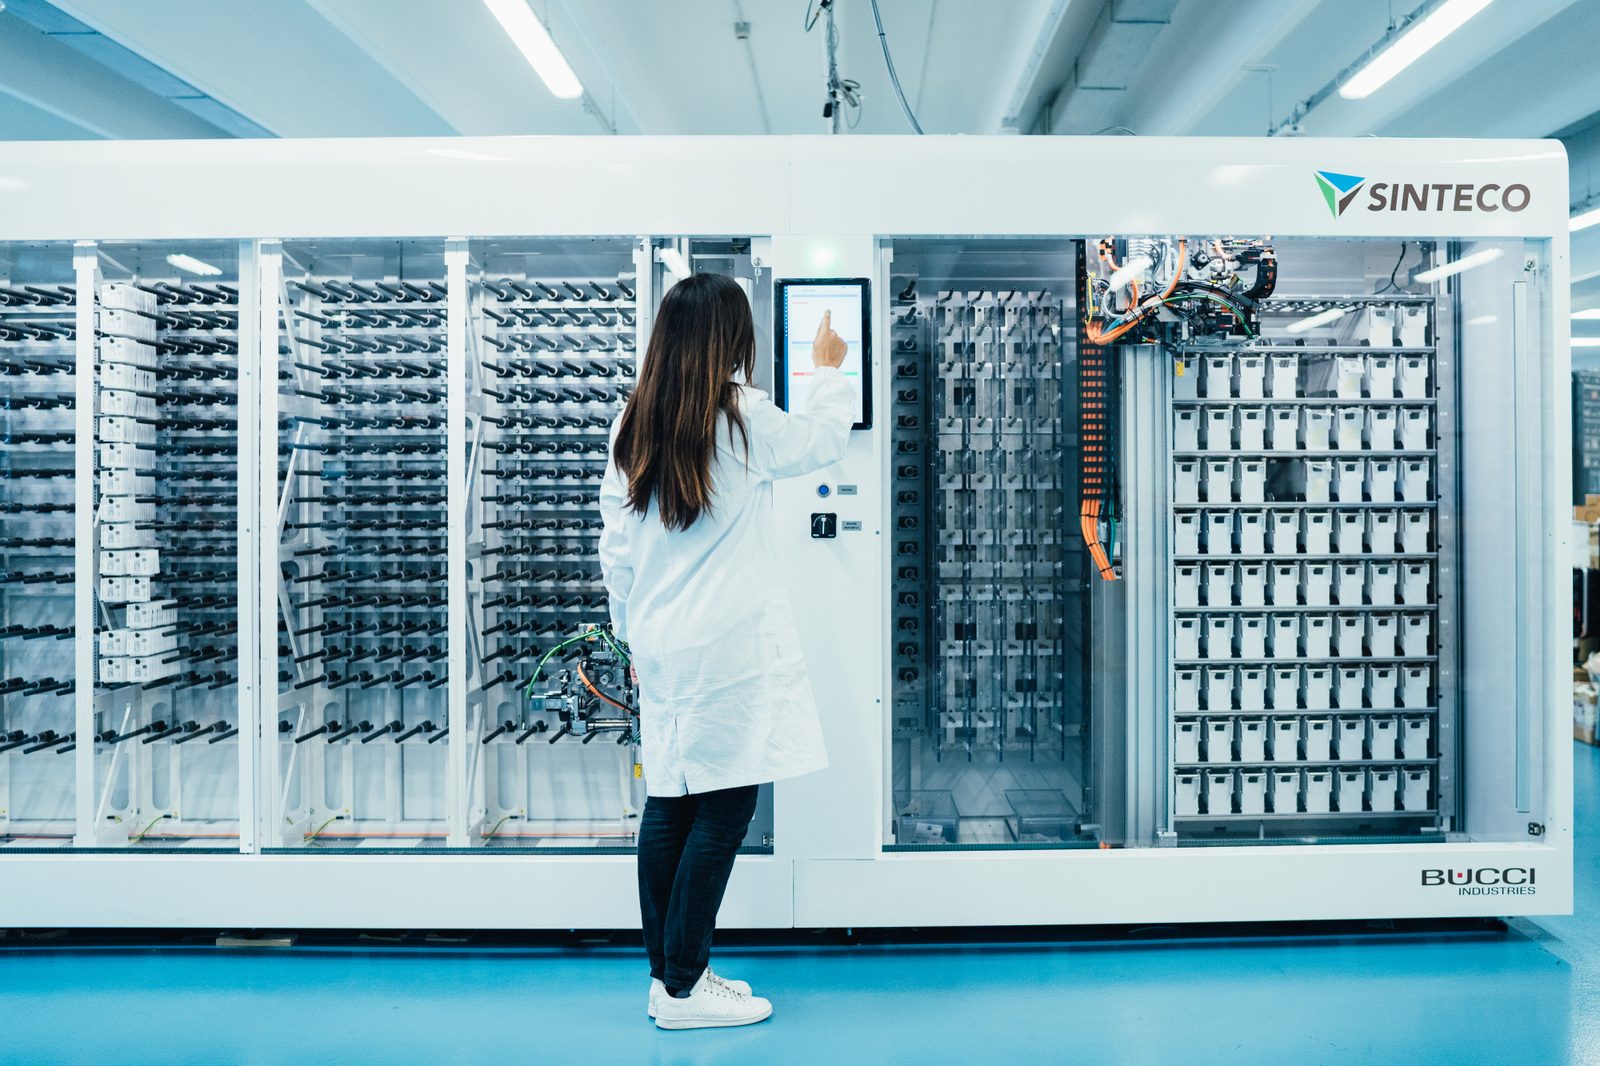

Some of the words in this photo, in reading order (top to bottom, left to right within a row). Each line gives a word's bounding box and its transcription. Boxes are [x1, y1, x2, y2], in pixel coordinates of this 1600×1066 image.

[1367, 183, 1531, 212] SINTECO
[1421, 868, 1535, 886] BUCCI
[1458, 886, 1536, 896] INDUSTRIES
